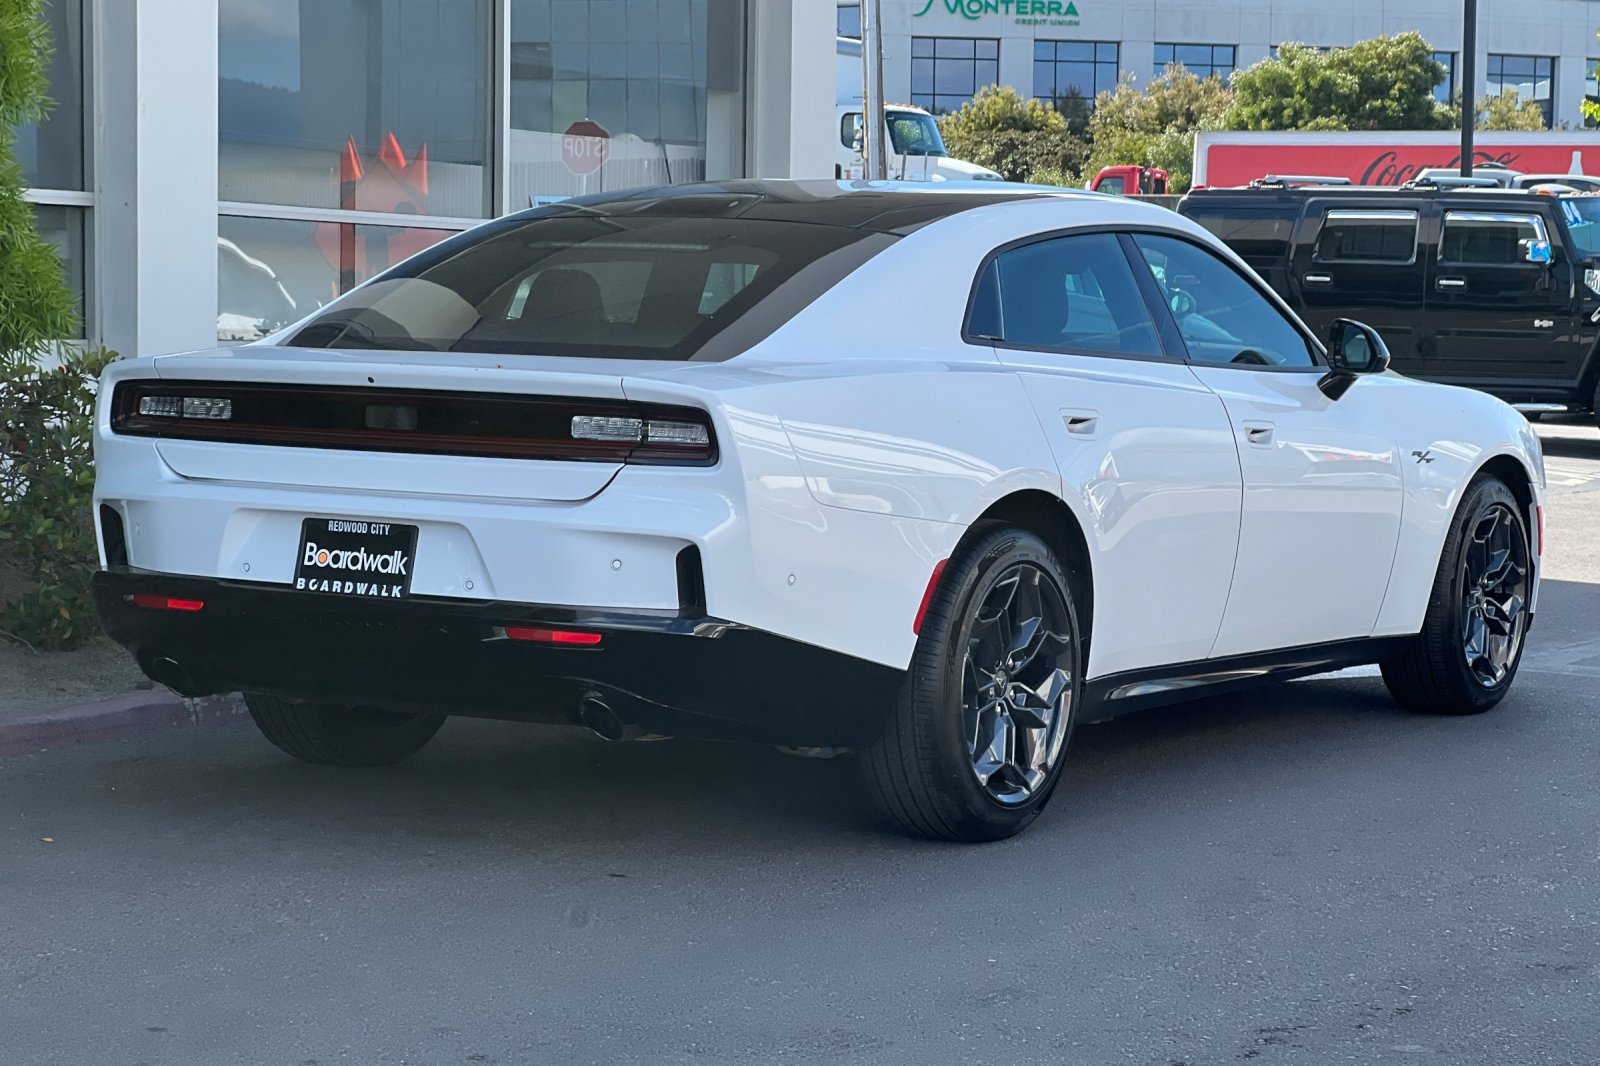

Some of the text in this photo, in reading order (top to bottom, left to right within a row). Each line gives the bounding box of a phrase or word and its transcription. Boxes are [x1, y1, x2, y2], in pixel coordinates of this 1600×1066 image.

[1050, 18, 1080, 26] UNION
[328, 520, 391, 536] REDWOOD CITY
[303, 541, 408, 576] Boardwalk
[296, 577, 403, 598] BOARDWALK
